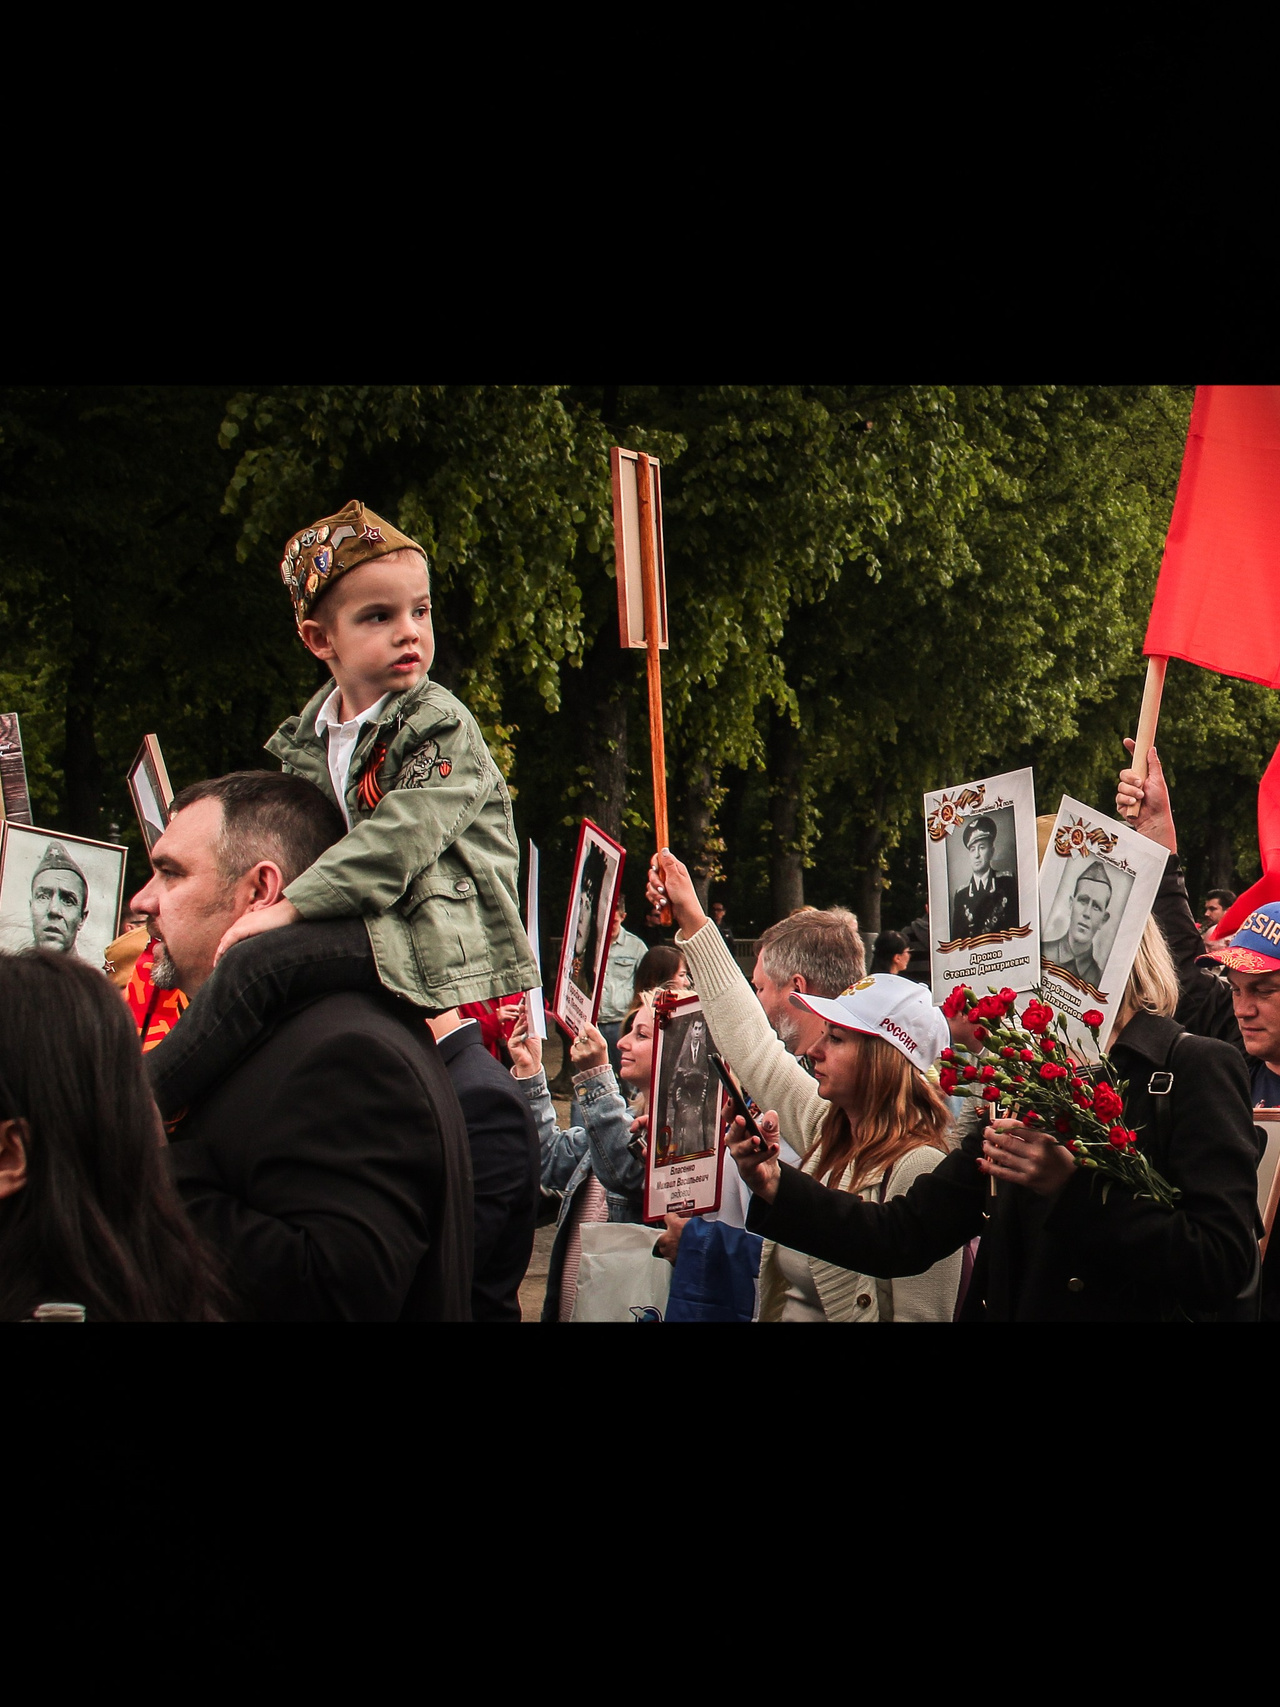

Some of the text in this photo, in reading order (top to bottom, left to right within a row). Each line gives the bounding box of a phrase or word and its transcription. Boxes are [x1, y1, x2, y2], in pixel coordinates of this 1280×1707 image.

[943, 956, 1030, 980] Степан Дмитриевич
[970, 950, 1002, 965] Дронов
[1041, 976, 1081, 1007] Барбашин
[1044, 991, 1084, 1021] Платонов
[879, 1018, 918, 1054] РОССИЯ
